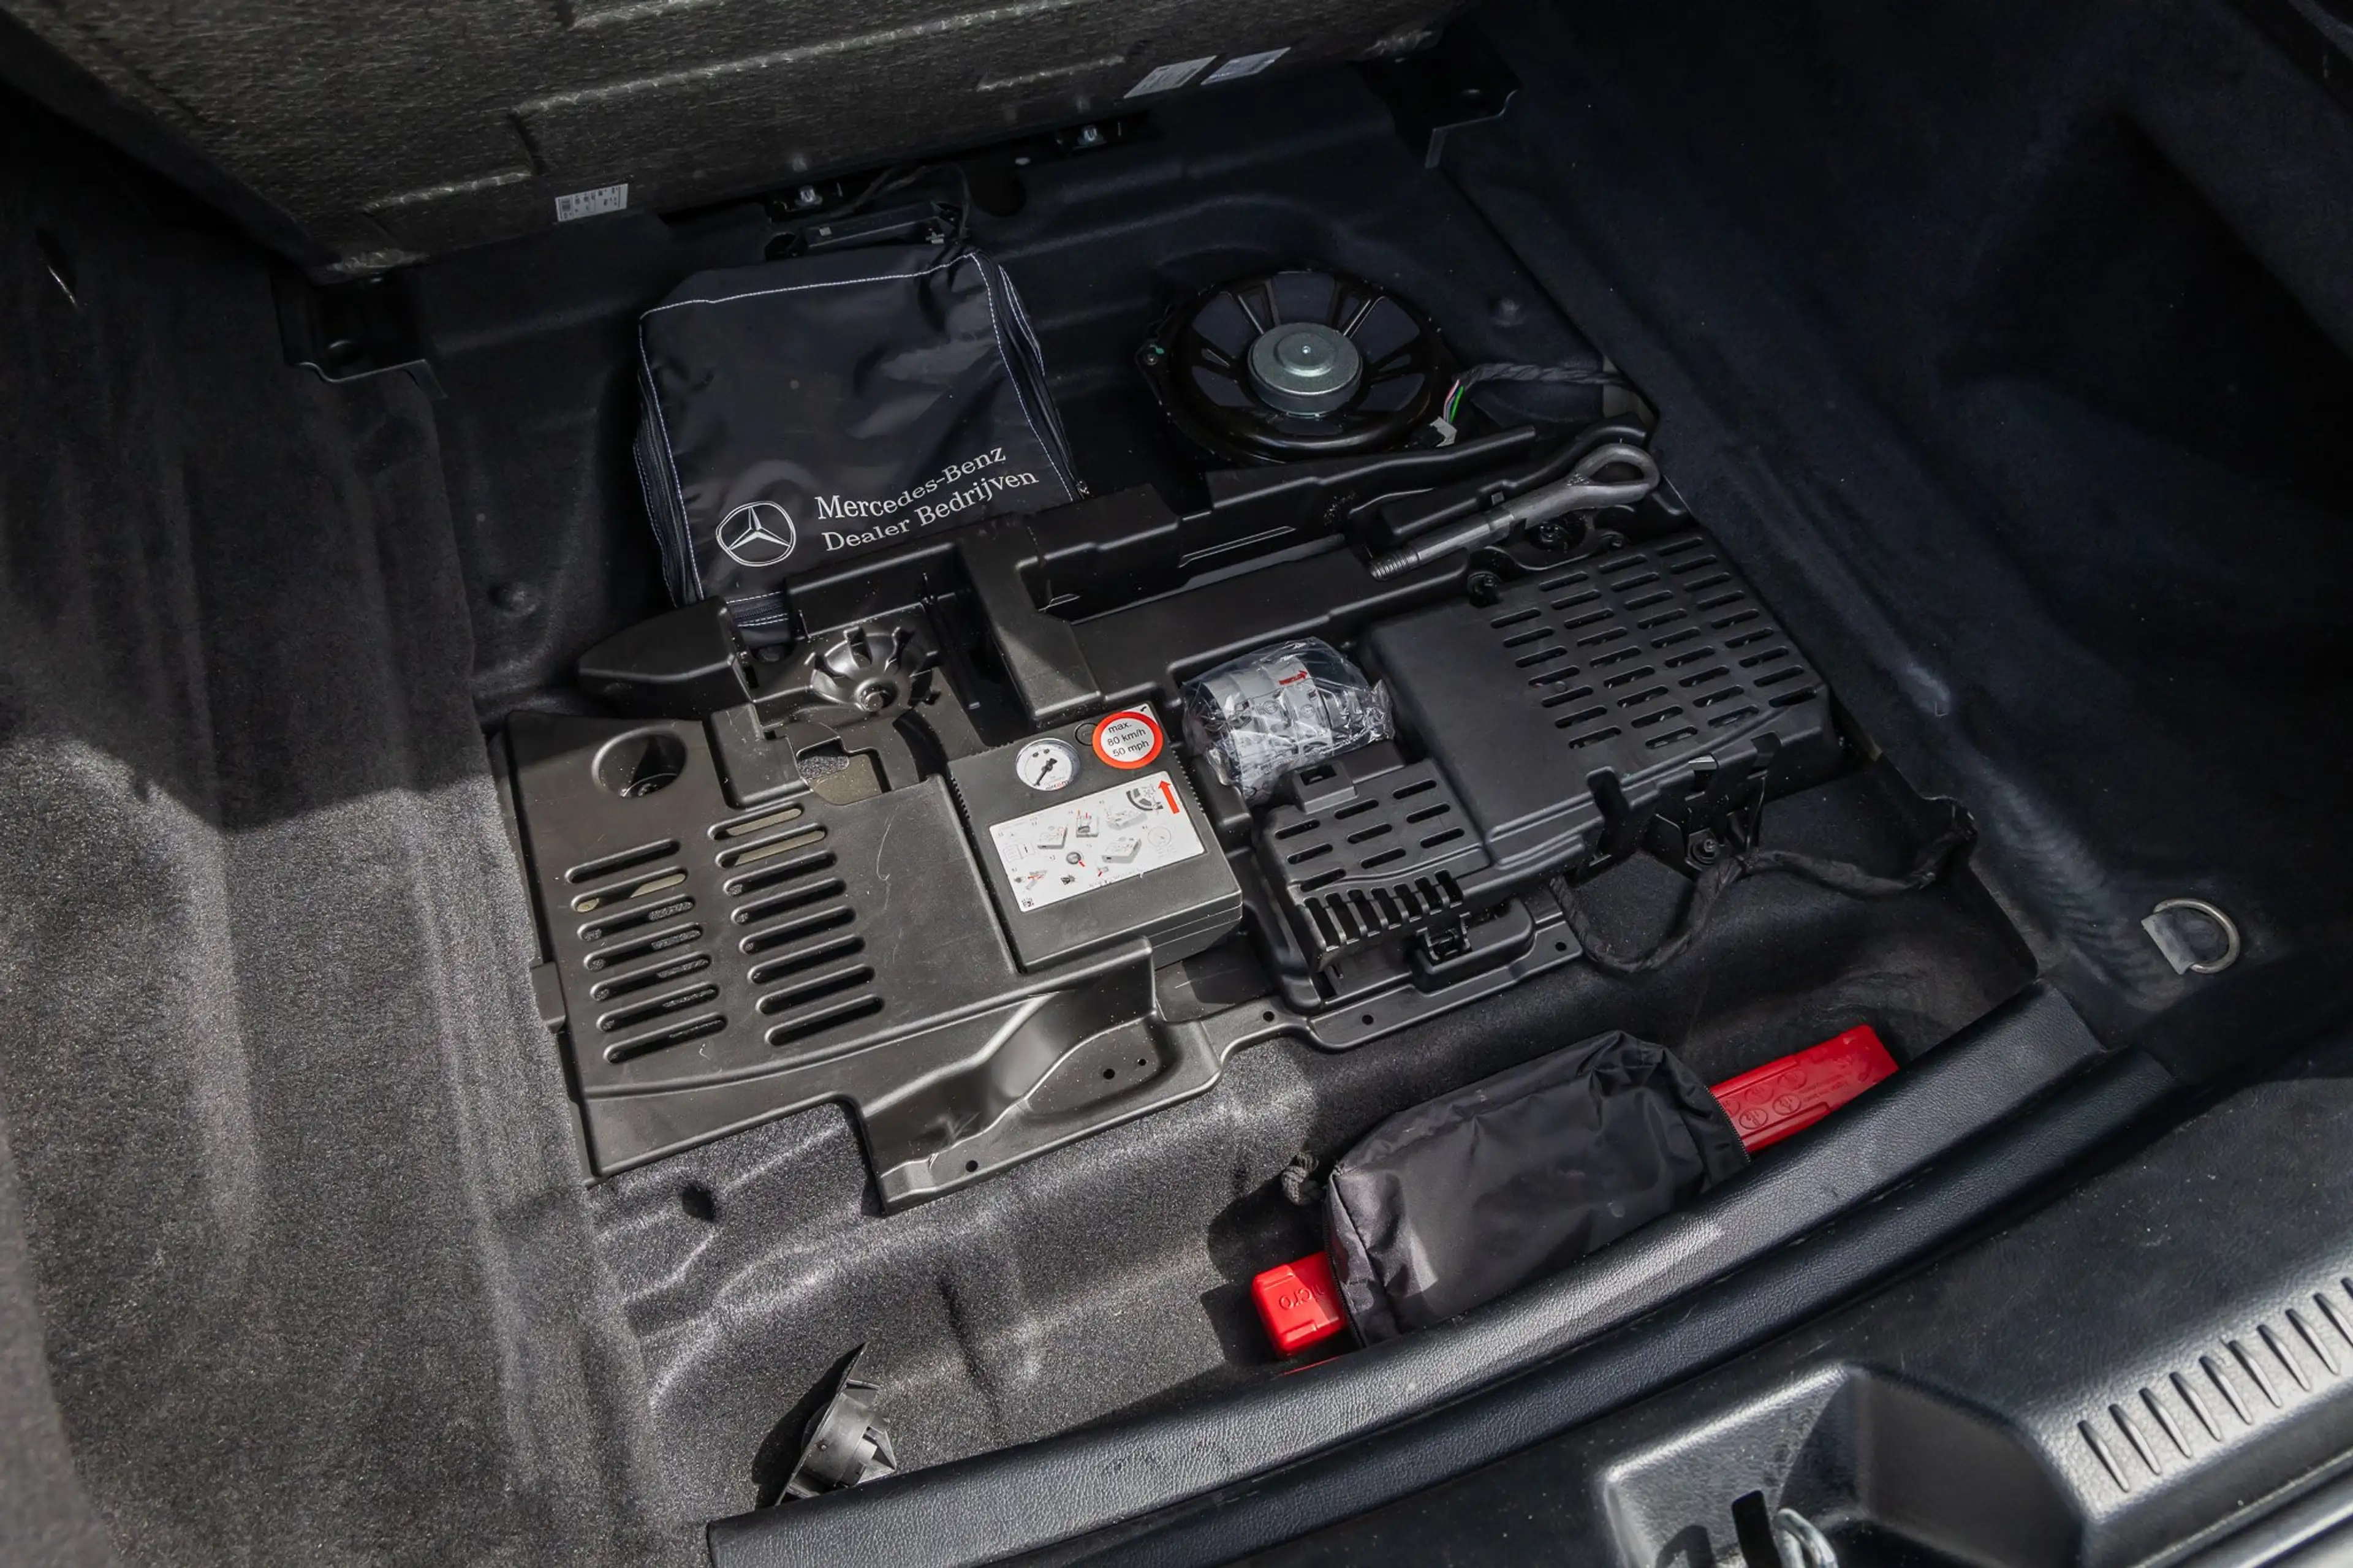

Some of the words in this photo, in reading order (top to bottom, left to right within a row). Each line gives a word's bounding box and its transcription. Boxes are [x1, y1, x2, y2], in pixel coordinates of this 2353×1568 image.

[814, 447, 1006, 519] Mercedes-Benz
[821, 519, 910, 551] Dealer
[914, 472, 1039, 526] Bedrijven
[1108, 722, 1132, 733] max.
[1107, 736, 1120, 746] 80
[1121, 728, 1146, 742] km/h
[1112, 748, 1126, 757] 50
[1127, 740, 1150, 752] mph
